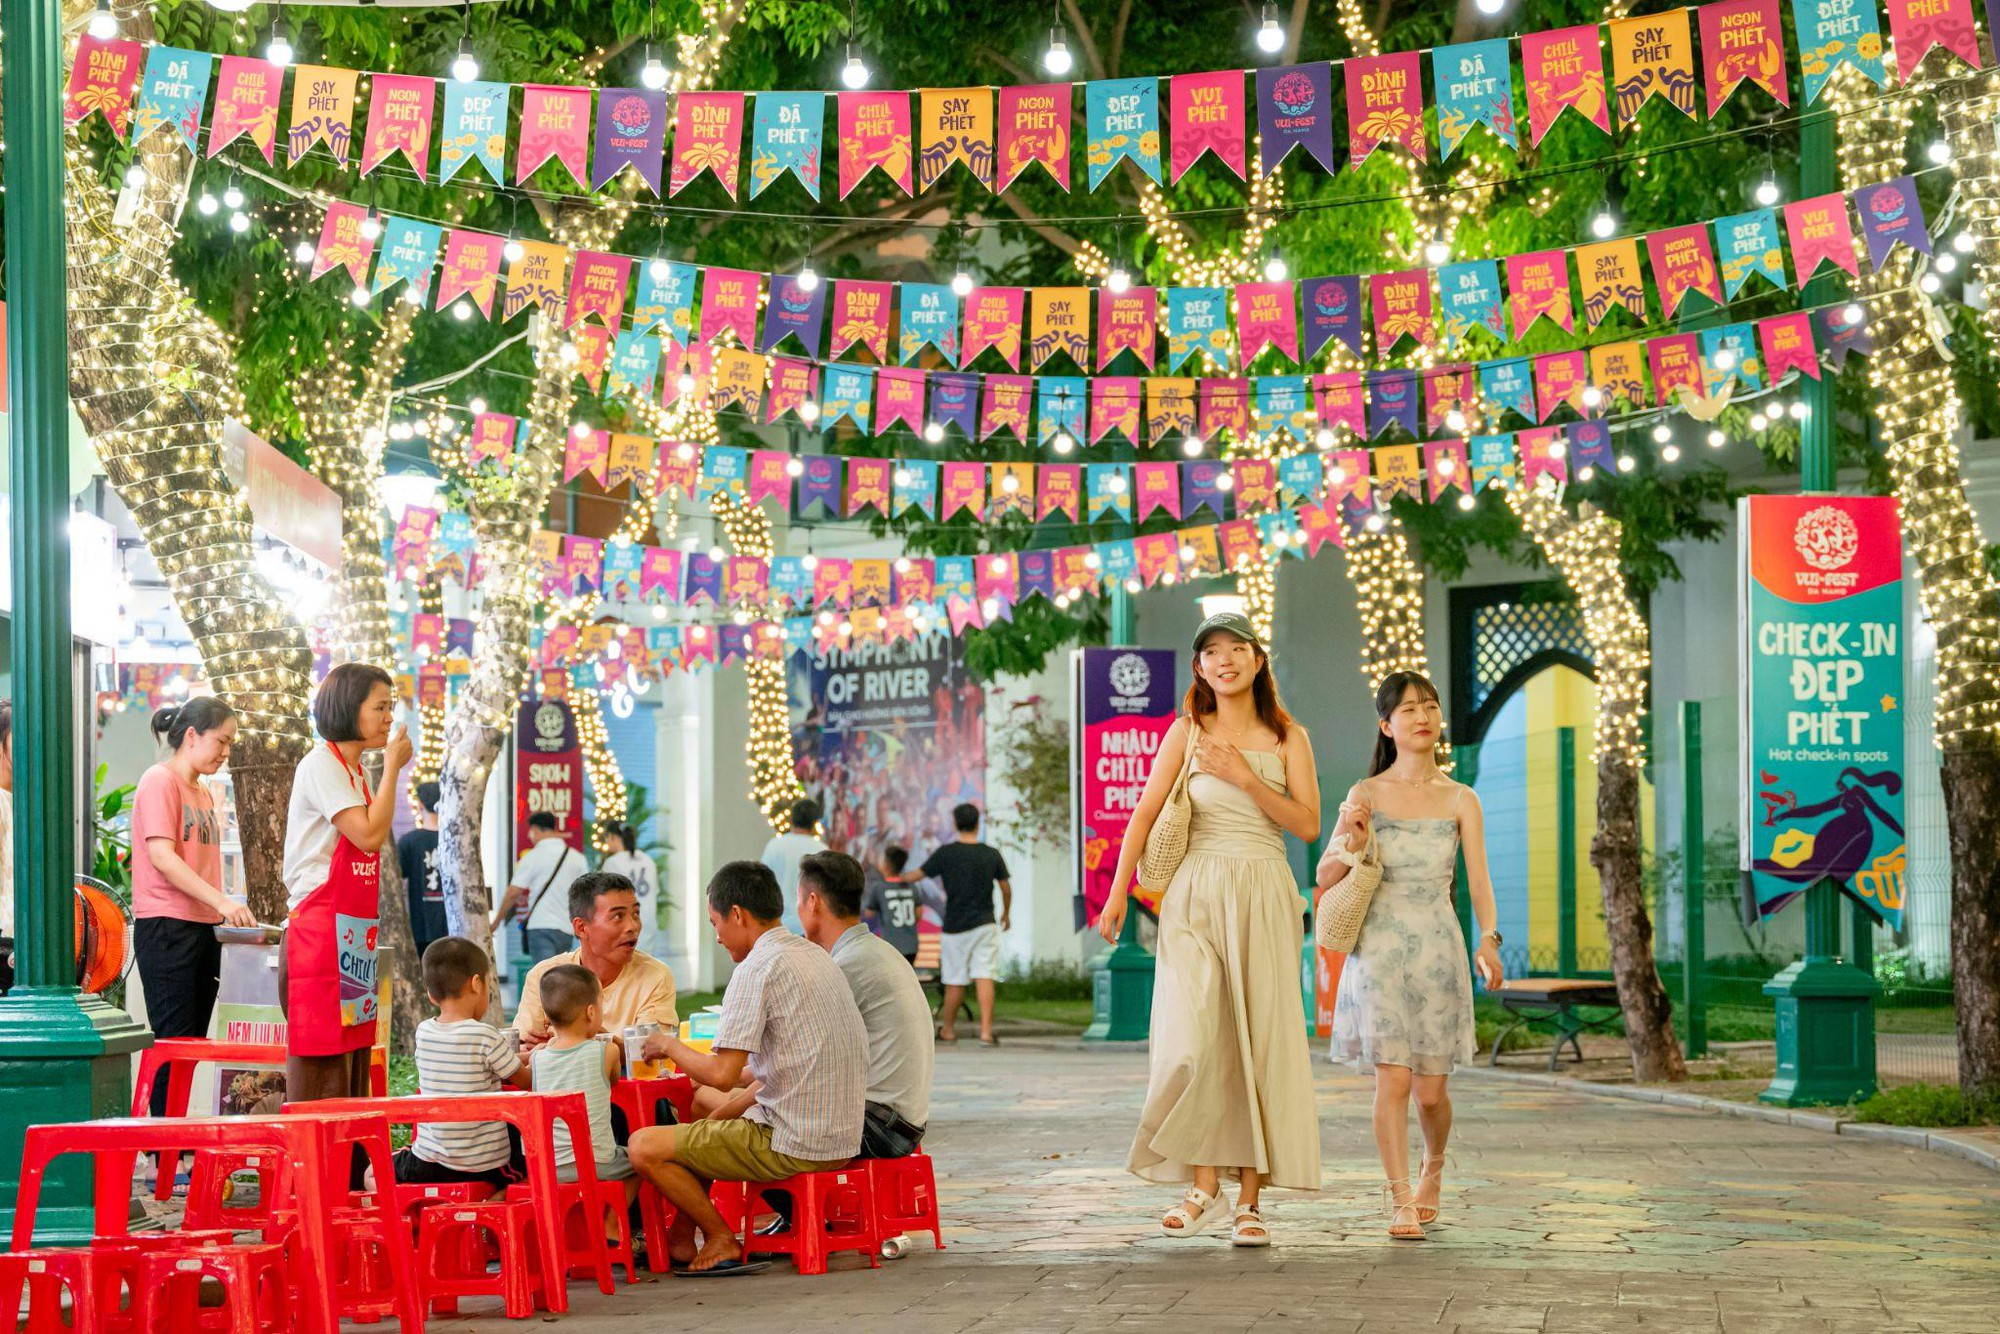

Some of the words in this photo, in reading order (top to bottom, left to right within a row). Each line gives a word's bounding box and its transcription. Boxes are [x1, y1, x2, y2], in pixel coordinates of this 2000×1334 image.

[1719, 10, 1762, 29] NGON
[1634, 26, 1665, 46] SAY
[1542, 38, 1580, 60] CHILL
[237, 71, 266, 87] CHILL
[312, 81, 336, 96] SAY
[389, 88, 420, 102] NGON
[542, 96, 571, 112] VUI
[1019, 97, 1054, 111] NGON
[1191, 86, 1223, 105] VUI
[858, 101, 892, 119] CHILL
[942, 98, 970, 116] SAY
[1795, 572, 1859, 587] VUI-FEST
[1758, 622, 1896, 657] CHECK-IN
[827, 671, 860, 704] OF
[863, 667, 930, 702] RIVER
[1789, 659, 1864, 707] ĐẸP
[1788, 702, 1870, 745] PHẾT
[1768, 748, 1792, 761] Hot
[1795, 748, 1850, 761] check-in
[1853, 750, 1888, 763] spots
[529, 763, 571, 783] SHOW
[888, 898, 915, 927] 30
[340, 951, 371, 982] CHILL
